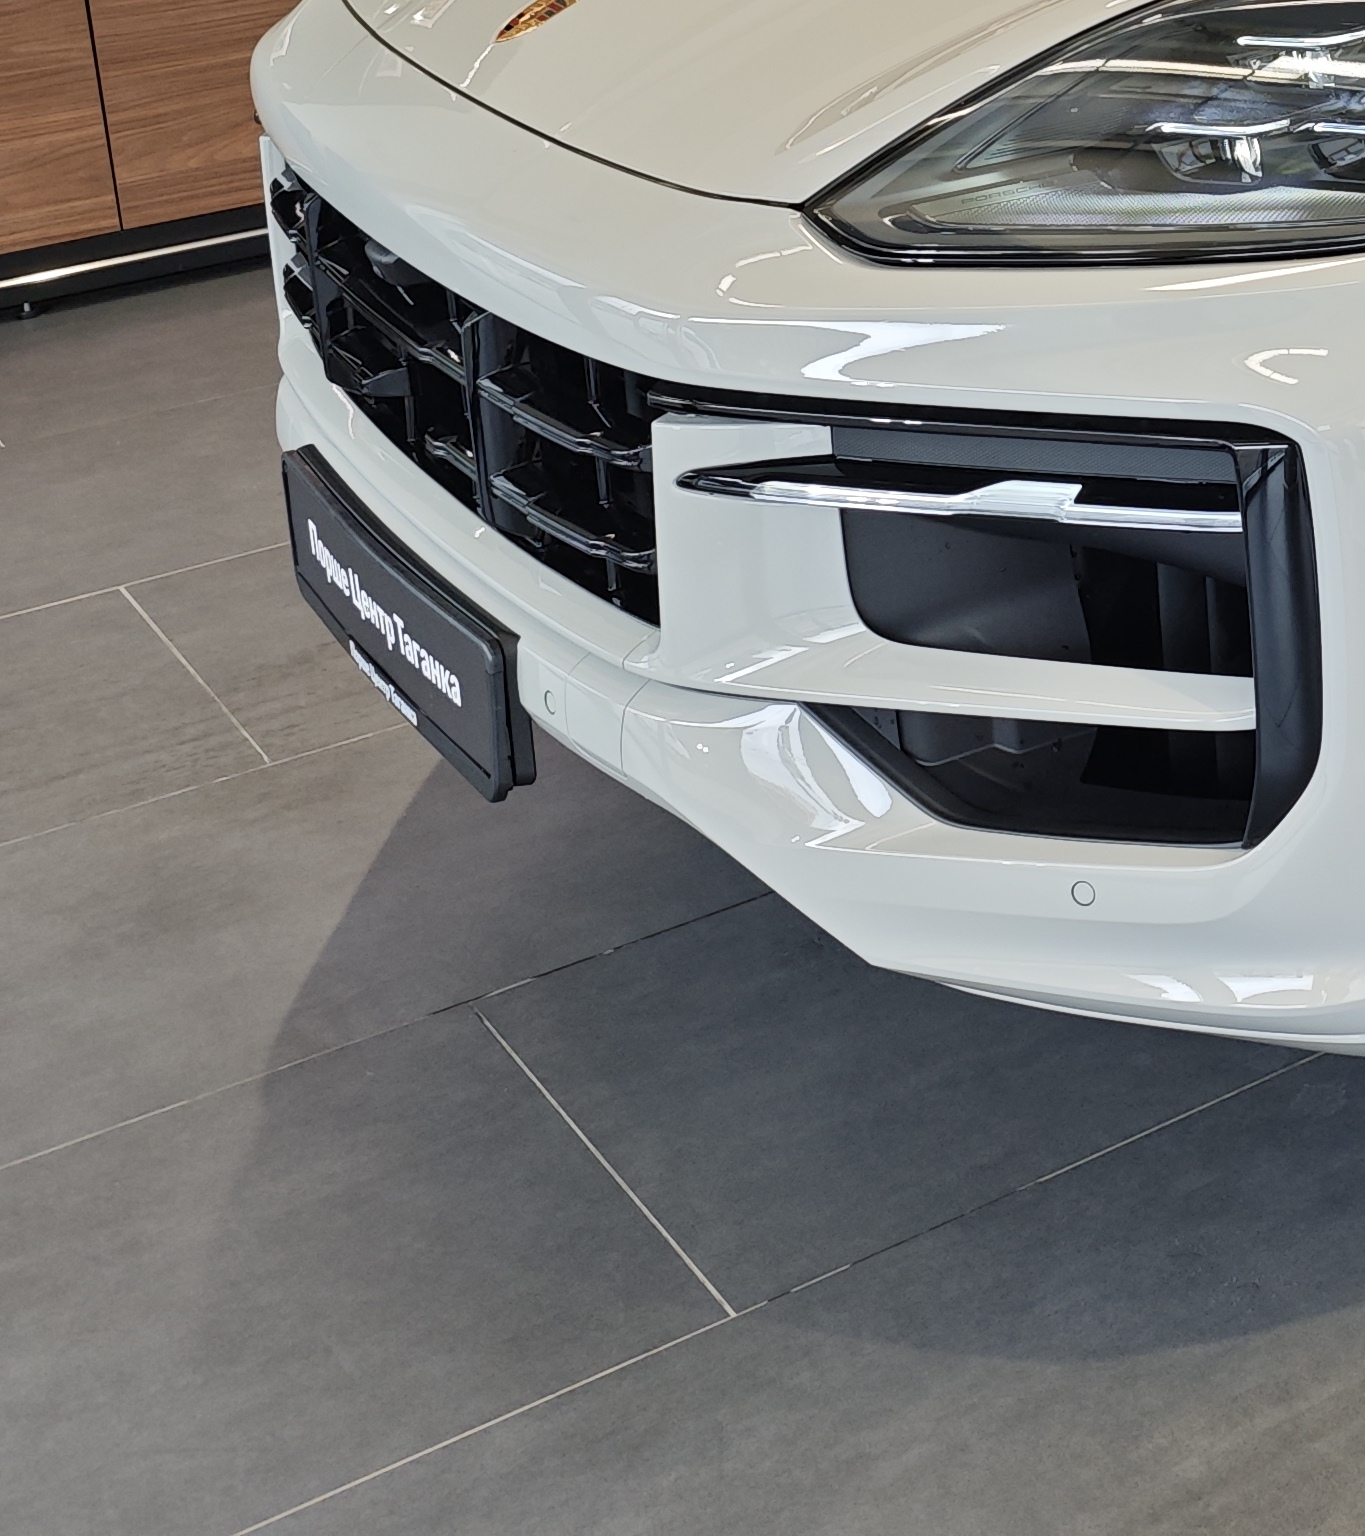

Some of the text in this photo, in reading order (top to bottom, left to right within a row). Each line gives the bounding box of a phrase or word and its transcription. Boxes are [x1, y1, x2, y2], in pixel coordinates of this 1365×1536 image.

[307, 518, 463, 708] Порше Центр Таганка
